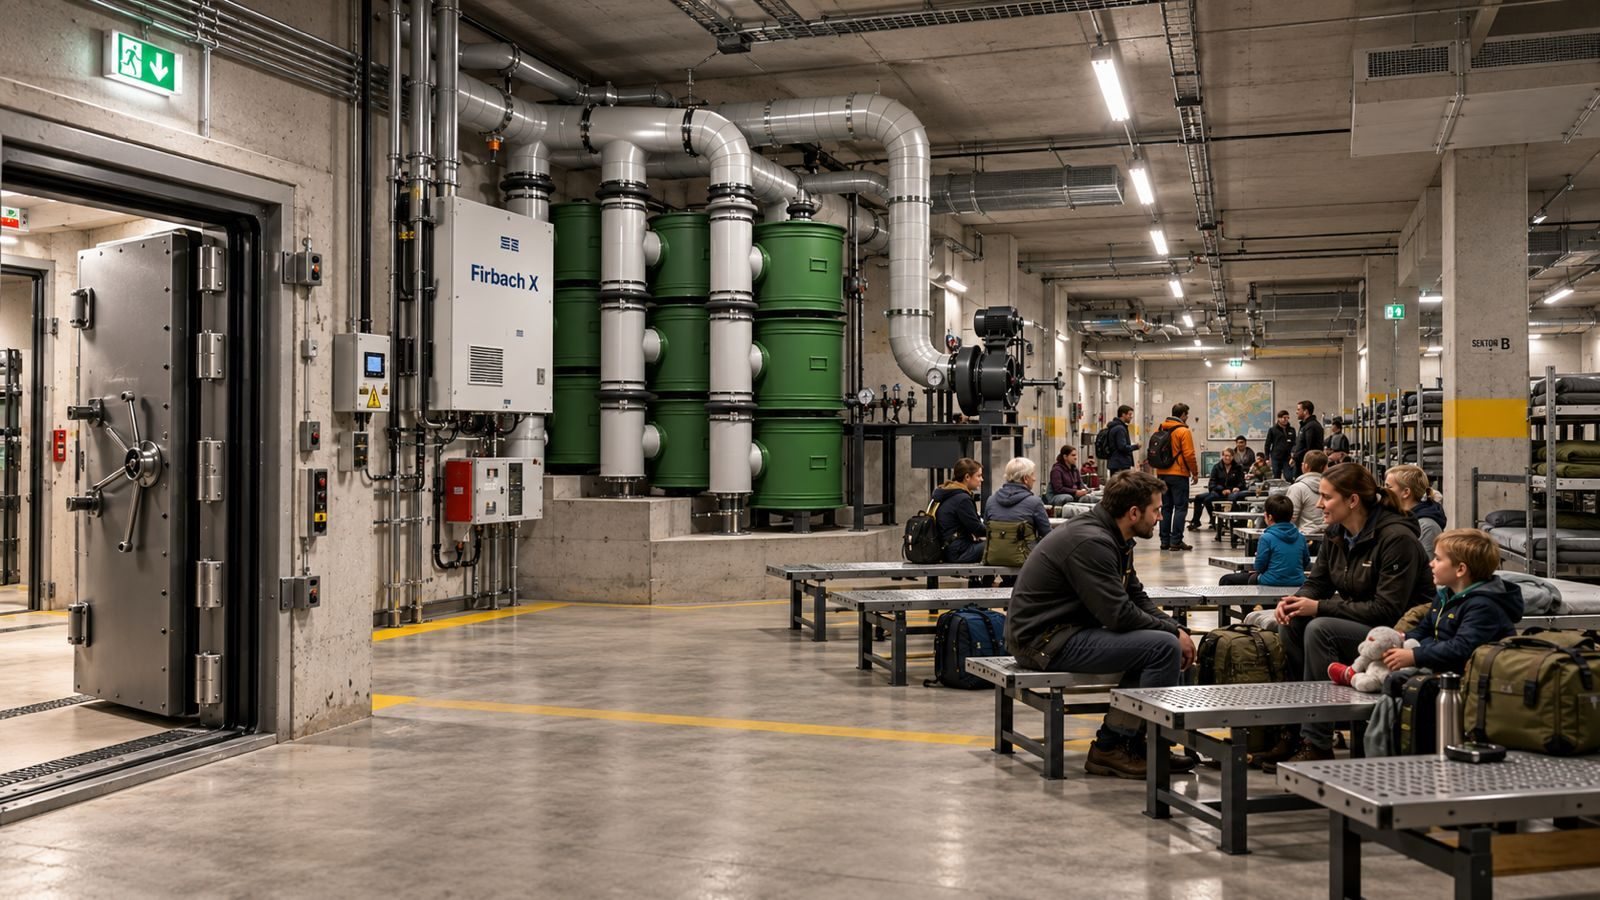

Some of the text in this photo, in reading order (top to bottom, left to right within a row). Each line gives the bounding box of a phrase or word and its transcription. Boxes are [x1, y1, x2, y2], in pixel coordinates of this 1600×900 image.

[471, 264, 539, 292] Firbach X
[1501, 338, 1510, 350] B
